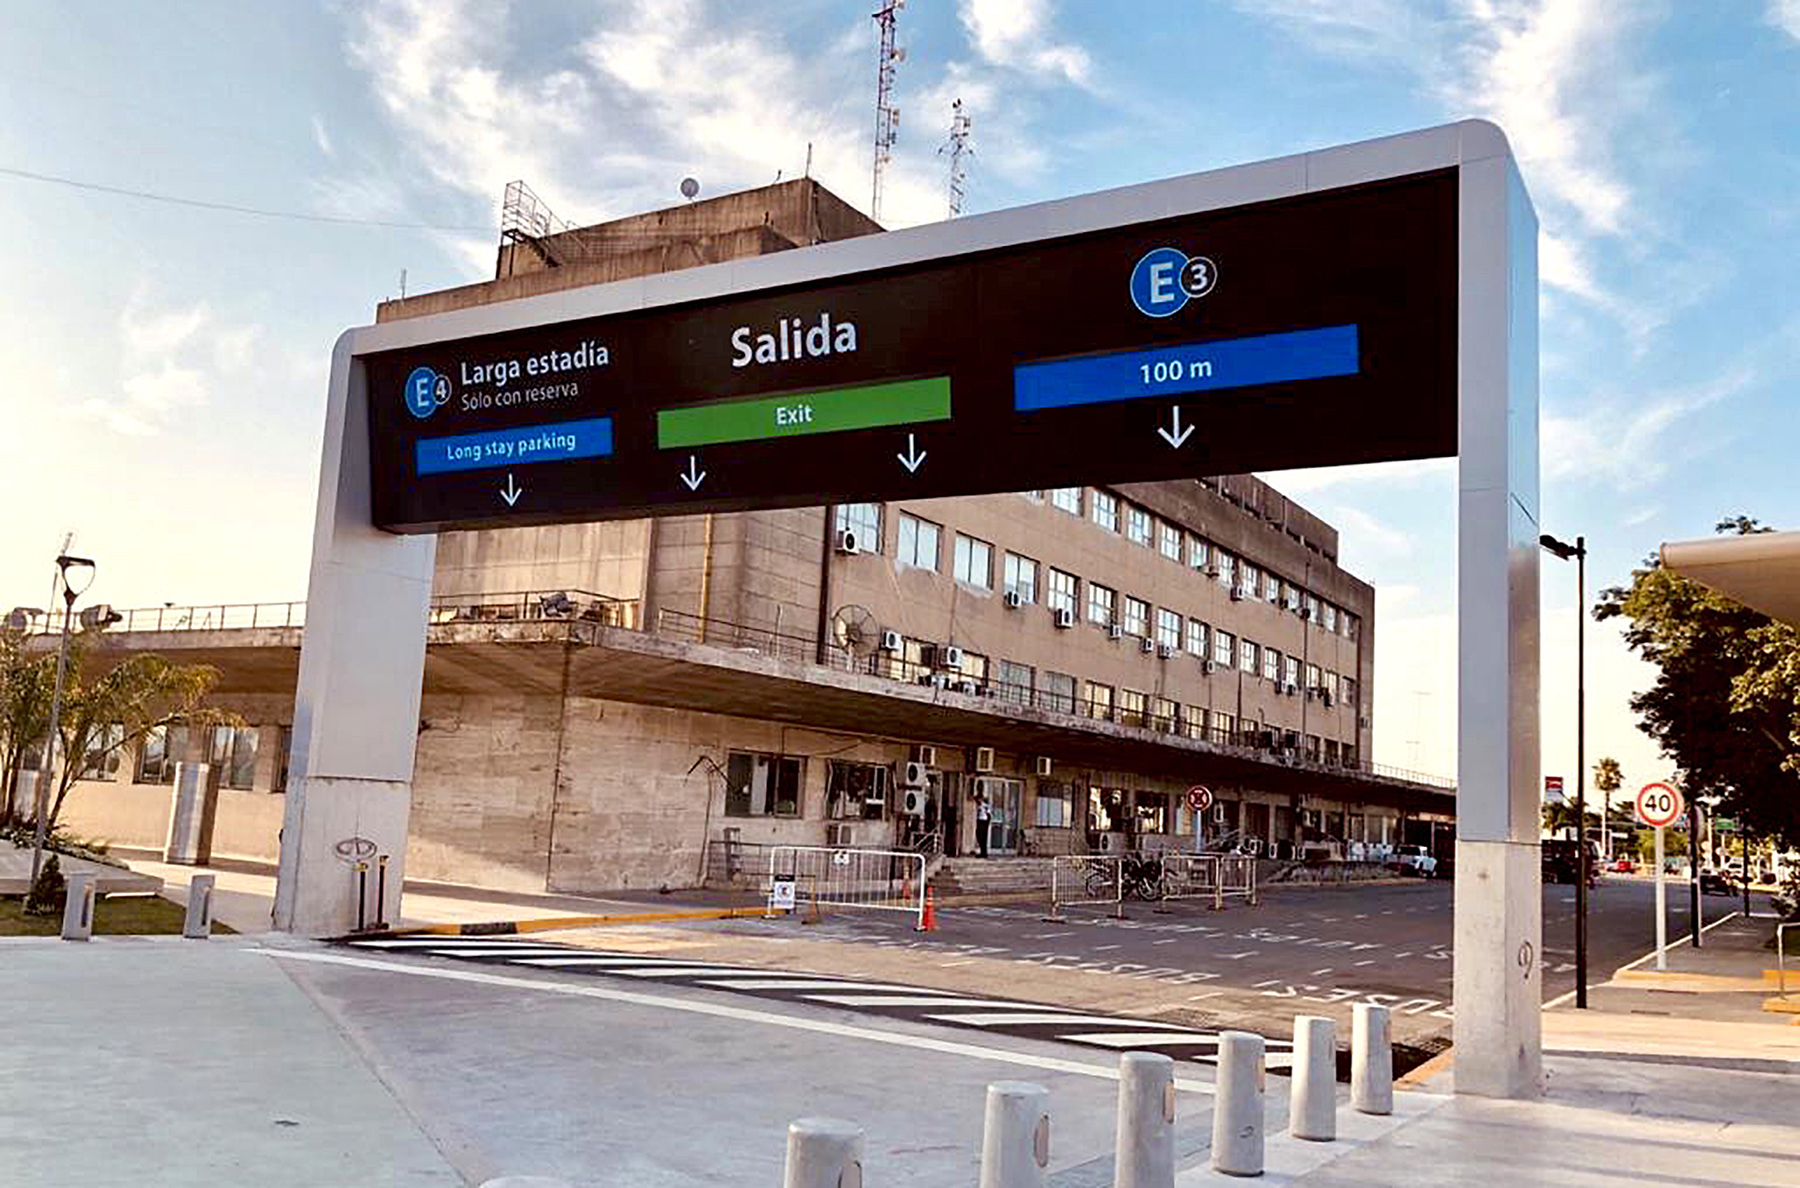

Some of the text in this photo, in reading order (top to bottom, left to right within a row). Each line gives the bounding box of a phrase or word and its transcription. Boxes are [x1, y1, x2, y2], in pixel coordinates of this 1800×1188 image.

[1150, 261, 1207, 303] E 3
[731, 312, 857, 368] Salida
[461, 340, 609, 387] Larga estadía
[1140, 360, 1212, 384] 100 m
[495, 390, 522, 406] con
[525, 382, 579, 402] reserva
[776, 404, 813, 425] Exit
[447, 432, 576, 461] Long stay parking
[1645, 794, 1671, 812] 40
